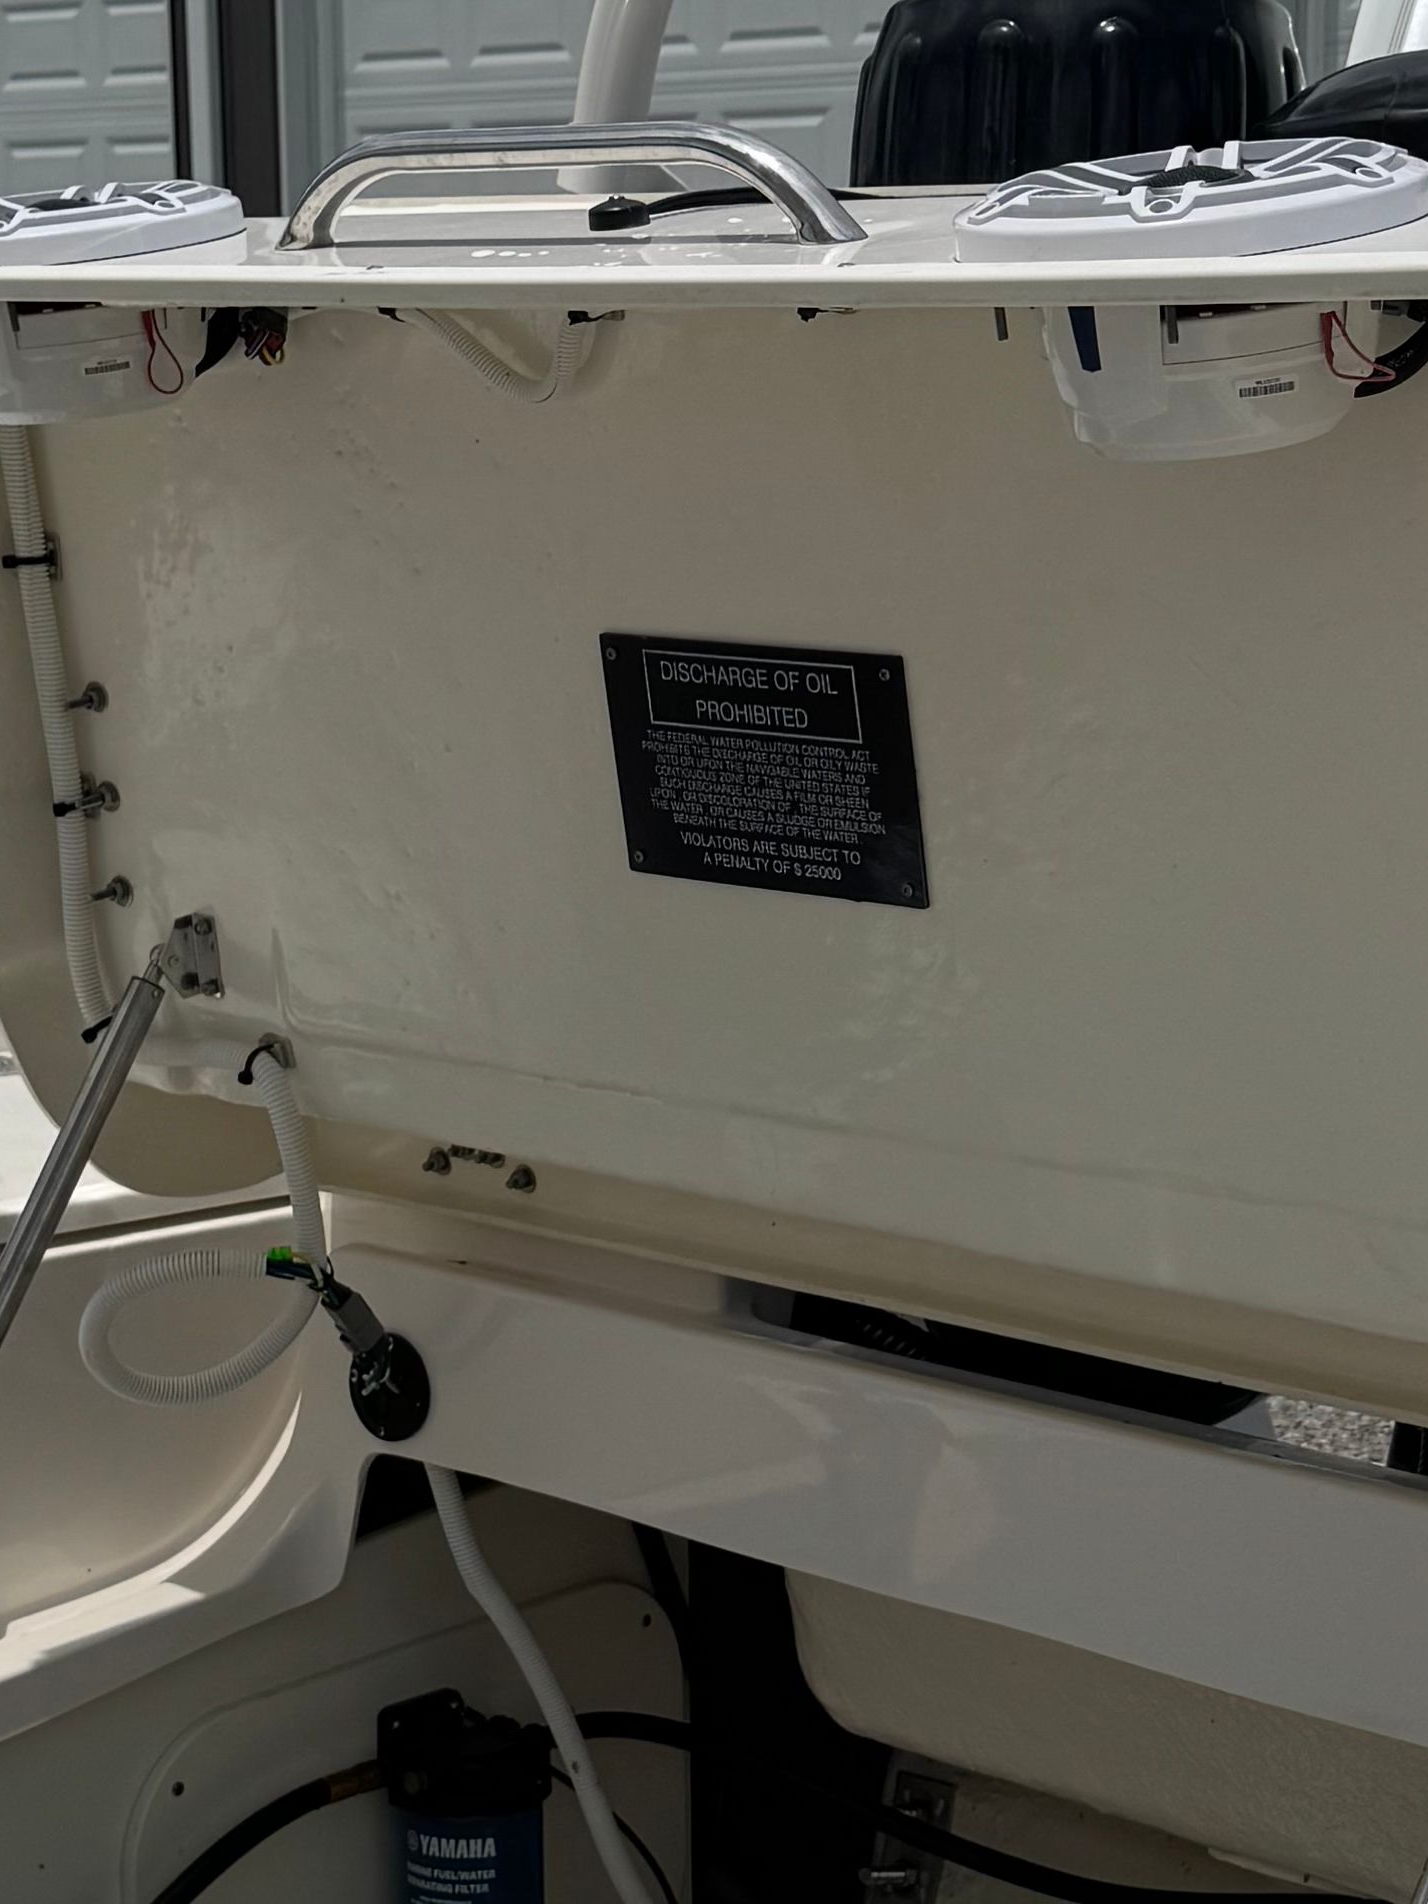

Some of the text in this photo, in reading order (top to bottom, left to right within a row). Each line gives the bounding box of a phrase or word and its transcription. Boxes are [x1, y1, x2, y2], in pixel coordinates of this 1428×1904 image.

[659, 660, 838, 695] DISCHARGE OF OIL
[694, 698, 808, 729] PROHIBITED
[680, 830, 861, 865] VIOLATORS ARE SUBJECT TO
[702, 850, 842, 881] A PENALTY OF $ 25000
[419, 1834, 498, 1860] YAMAHA
[433, 1869, 497, 1883] FUEL/WATER
[455, 1883, 491, 1895] FILTER
